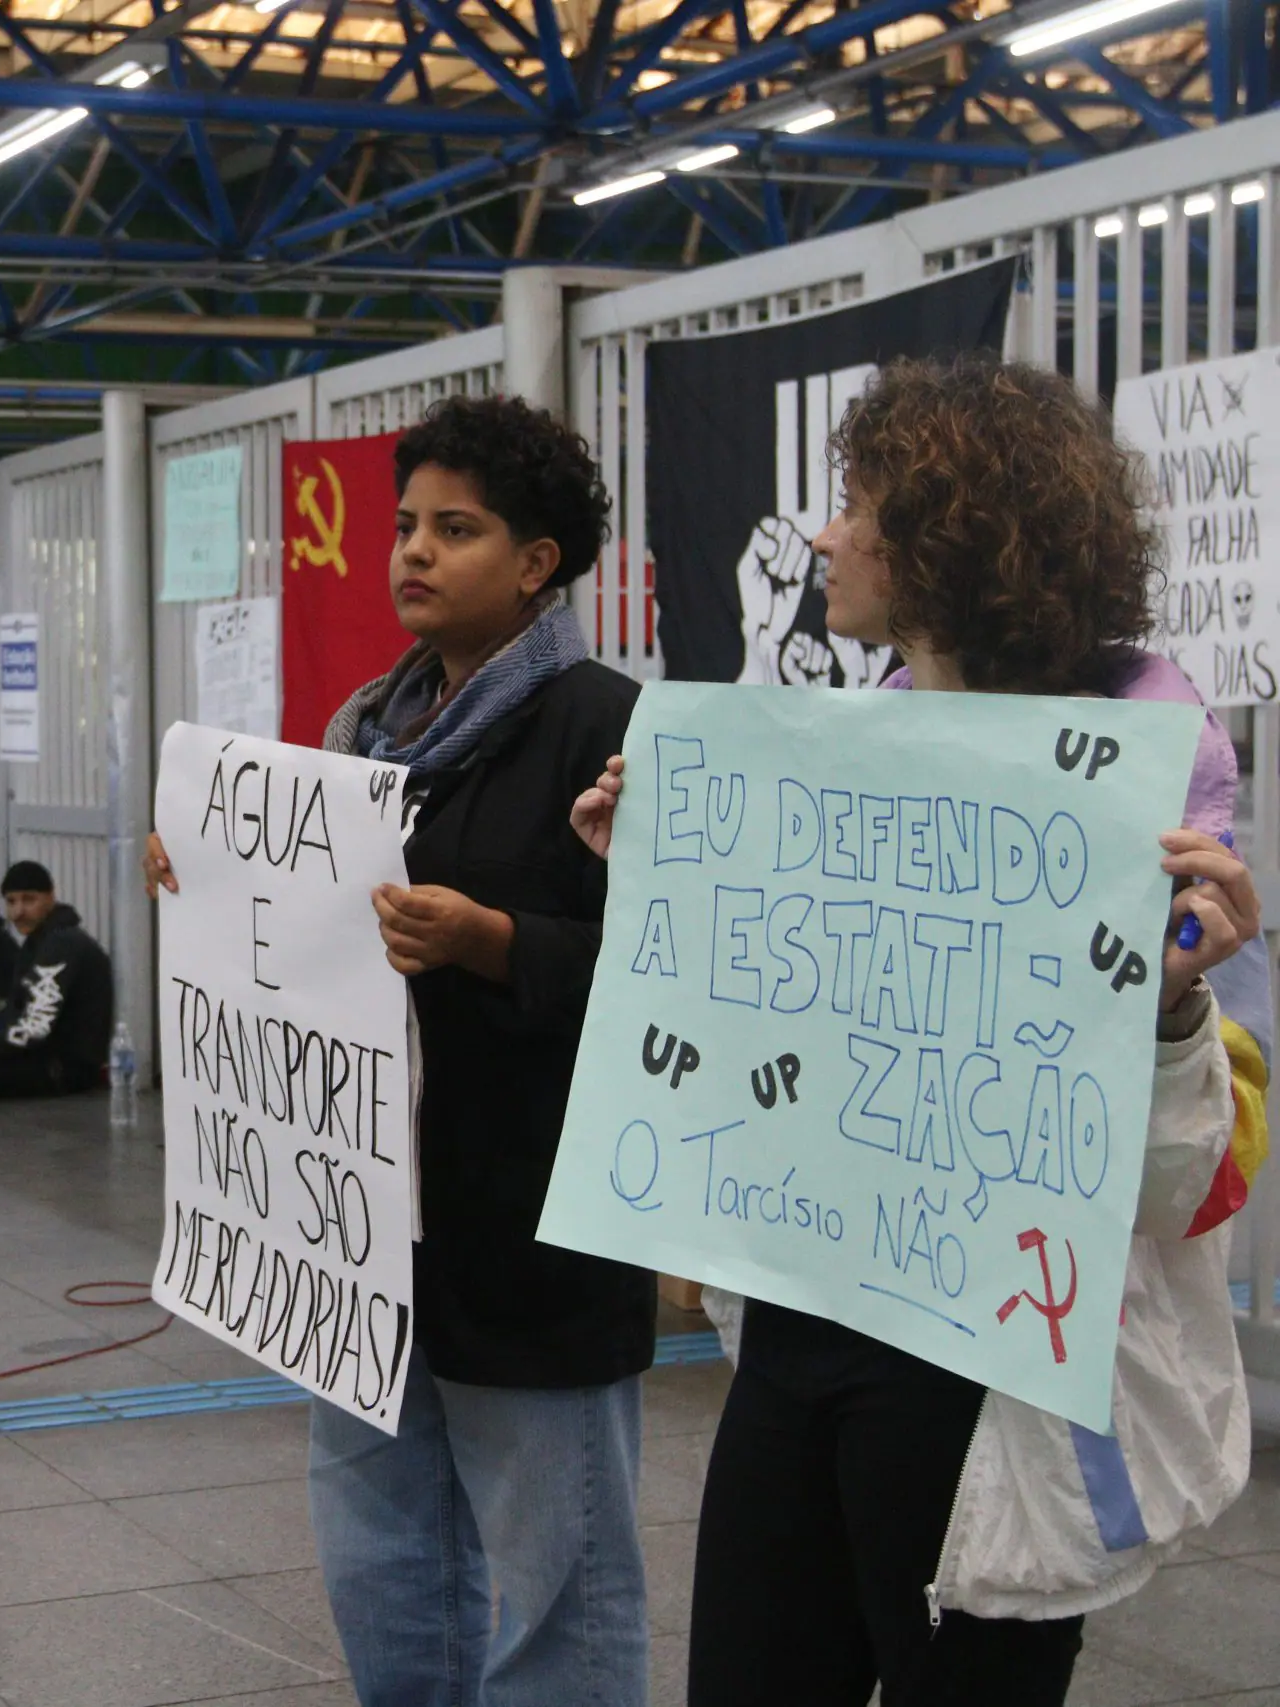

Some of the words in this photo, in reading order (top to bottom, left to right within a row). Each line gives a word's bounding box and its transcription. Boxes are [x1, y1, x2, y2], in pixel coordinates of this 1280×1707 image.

[1149, 373, 1213, 442] VIA
[1157, 432, 1262, 511] AMIDADE
[1187, 506, 1261, 567] FALHA
[1164, 577, 1225, 638] CADA
[1214, 640, 1277, 700] DIAS
[1054, 726, 1120, 780] UP
[201, 738, 338, 884] ÁGUA
[772, 778, 1089, 909] DEFENDO
[252, 895, 281, 991] E
[631, 899, 678, 978] A
[1088, 921, 1148, 993] UP
[172, 976, 396, 1166] TRANSPORTE
[642, 1022, 701, 1090] UP
[750, 1052, 802, 1110] UP
[839, 1019, 1110, 1223] ZAÇÃO
[194, 1103, 269, 1219] NÃO
[294, 1149, 371, 1266] SÃO
[680, 1118, 844, 1243] Tarcísio
[872, 1186, 967, 1298] NÃO
[164, 1200, 409, 1418] MERCADORIAS!
